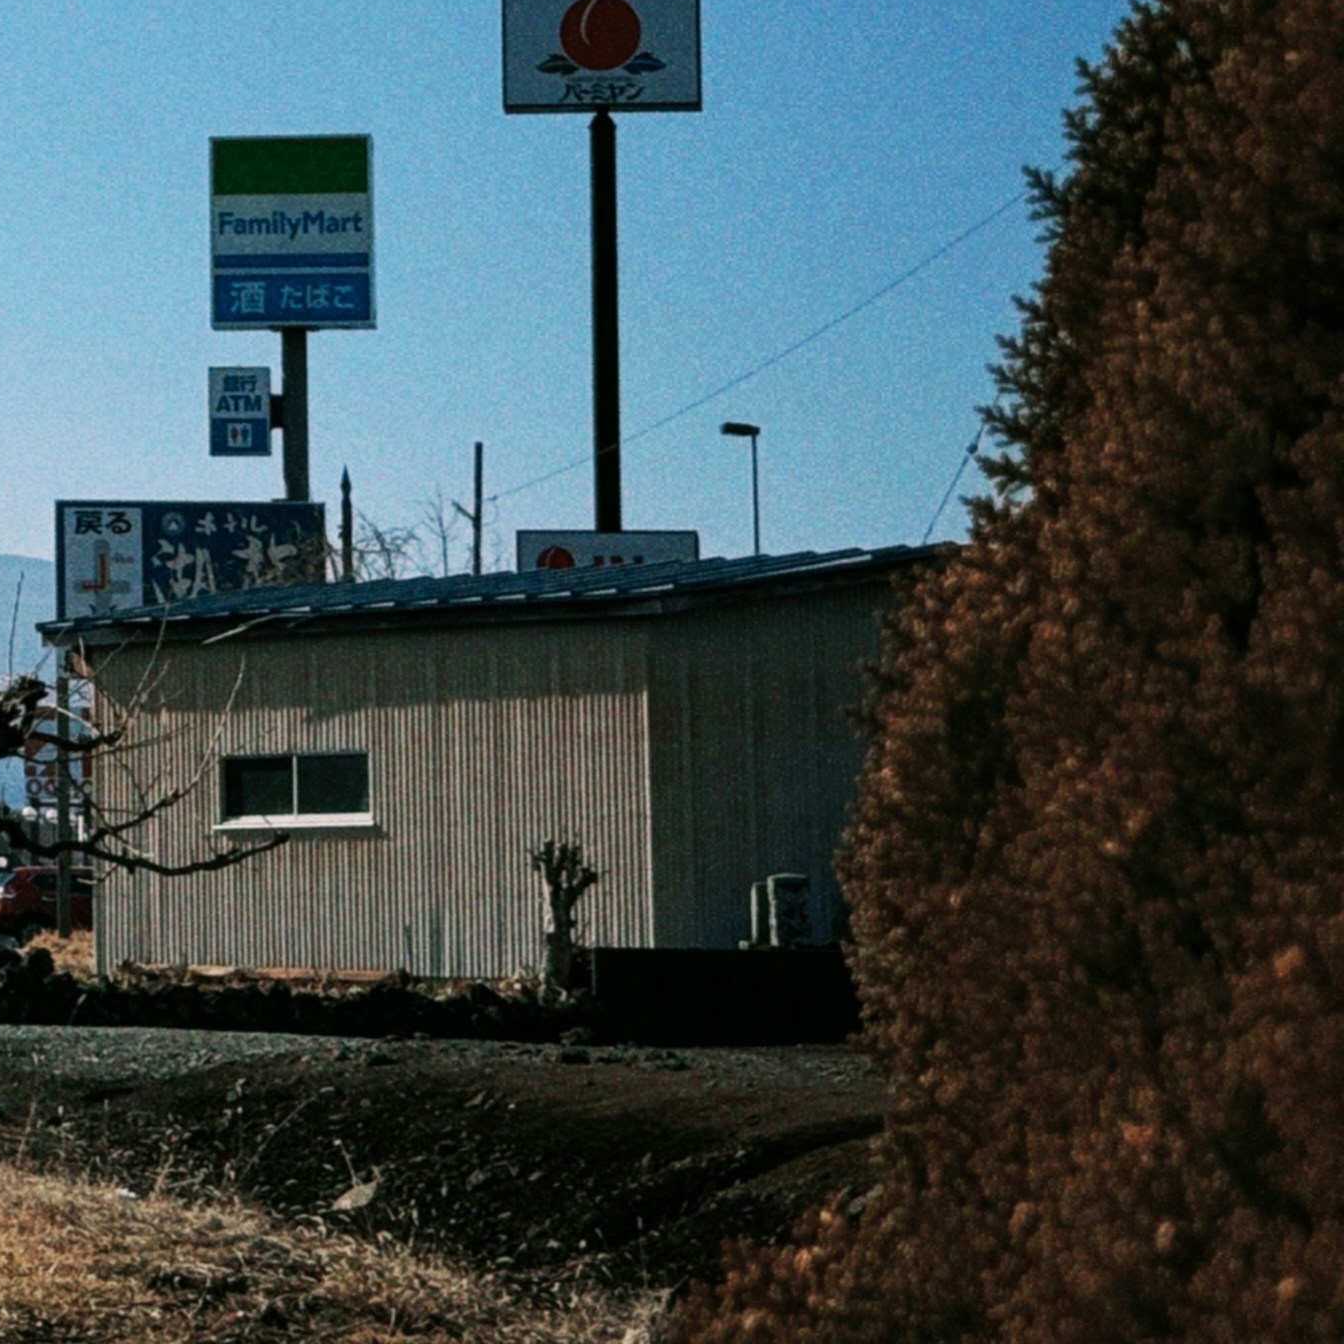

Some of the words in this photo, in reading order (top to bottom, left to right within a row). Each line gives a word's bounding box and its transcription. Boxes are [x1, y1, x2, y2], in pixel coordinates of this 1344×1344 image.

[559, 83, 645, 102] バーミヤン
[218, 210, 363, 240] FamilyMart
[230, 280, 266, 314] 酒
[279, 283, 356, 310] たばこ
[223, 373, 257, 393] 銀行
[215, 394, 263, 413] ATM
[73, 510, 132, 535] 戻る
[194, 511, 269, 536] ホテル
